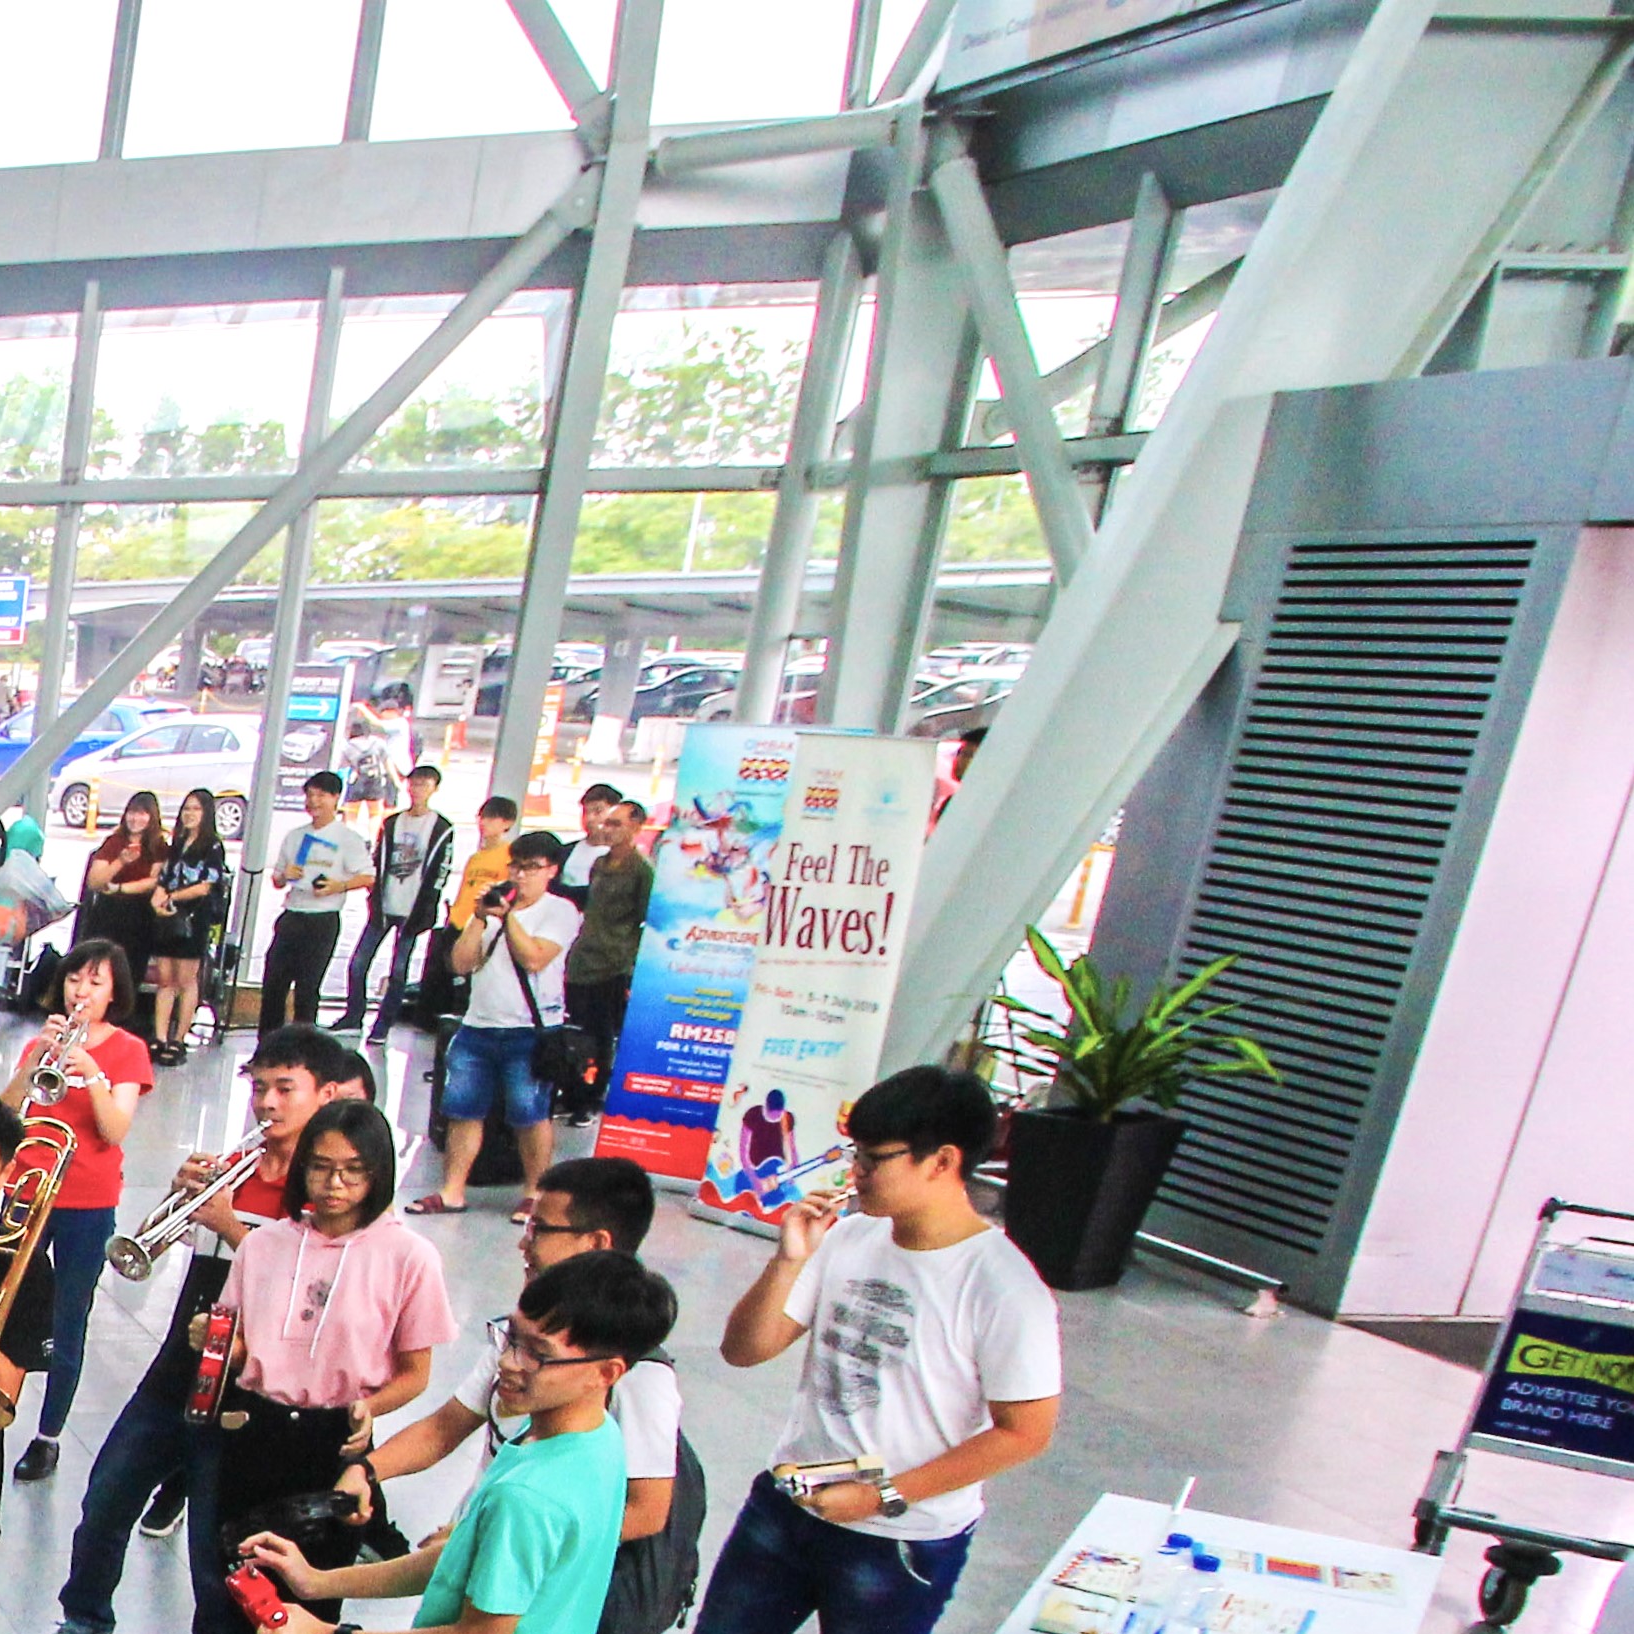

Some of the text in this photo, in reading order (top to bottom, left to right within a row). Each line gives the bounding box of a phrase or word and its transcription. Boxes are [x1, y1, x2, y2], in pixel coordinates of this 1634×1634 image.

[783, 842, 890, 887] Feel The
[765, 886, 894, 956] Waves!
[1519, 1344, 1582, 1371] GET
[1500, 1397, 1564, 1420] BRAND
[1566, 1410, 1615, 1430] HERE
[1505, 1381, 1634, 1416] ADVERTISE YO
